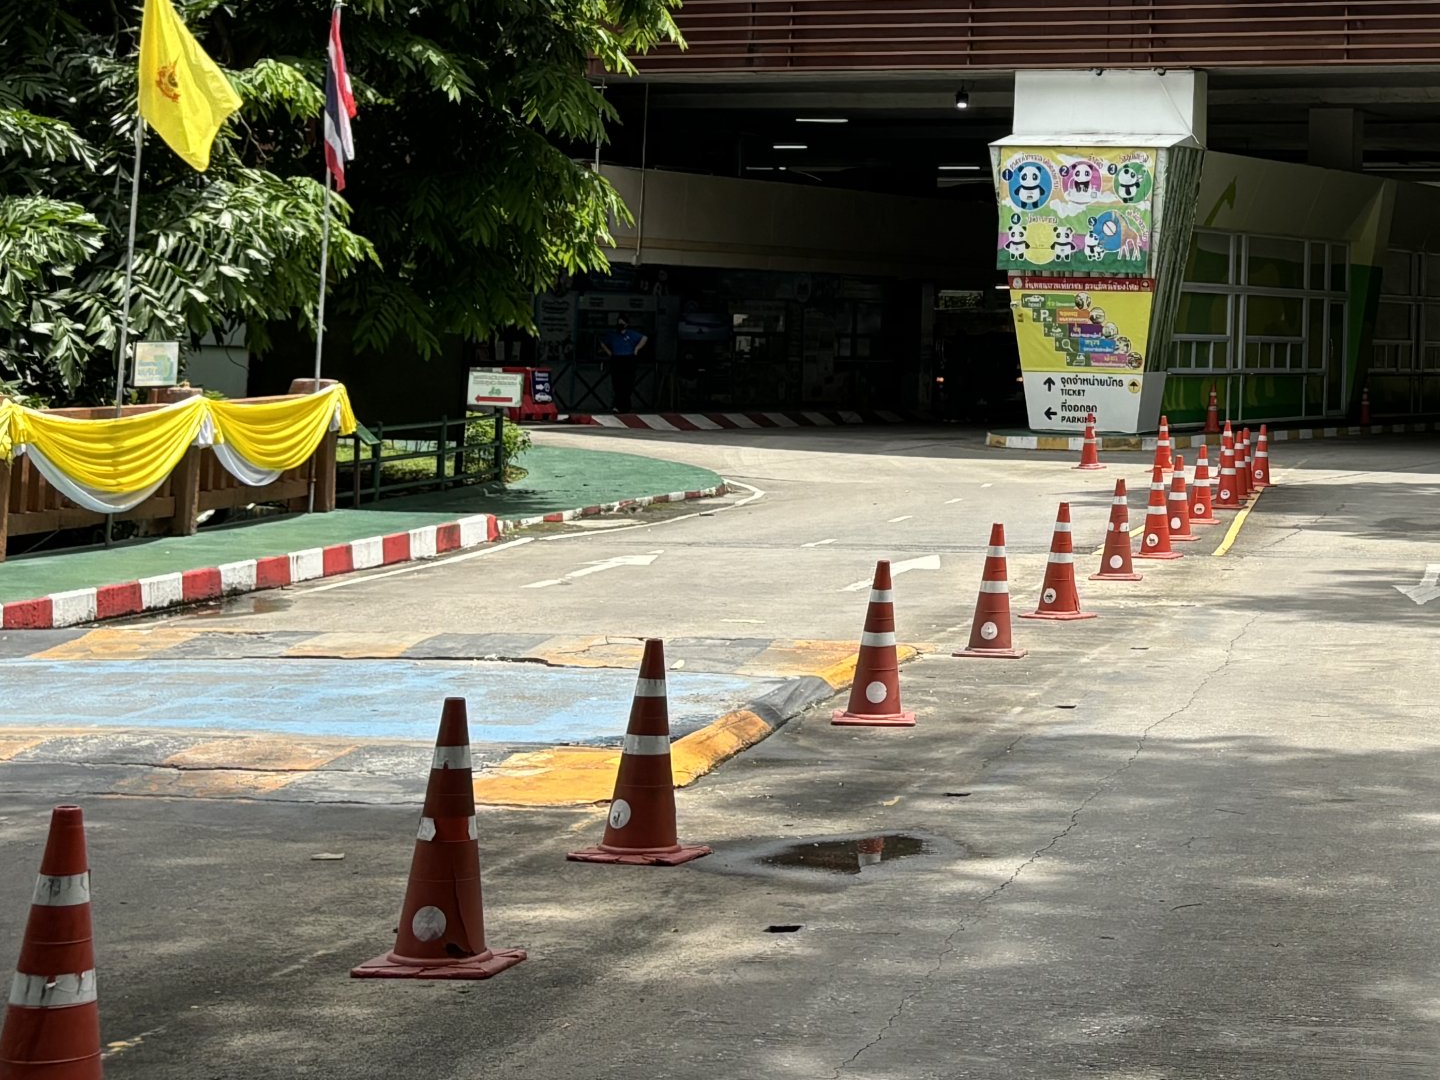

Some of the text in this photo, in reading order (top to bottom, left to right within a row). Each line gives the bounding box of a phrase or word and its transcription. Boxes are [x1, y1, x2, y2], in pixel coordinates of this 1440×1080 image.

[1040, 309, 1049, 321] P
[1060, 374, 1124, 388] จุดจำหน่ายบัตร
[1060, 389, 1086, 397] TICKET
[1060, 399, 1098, 413] ที่จอดรถ
